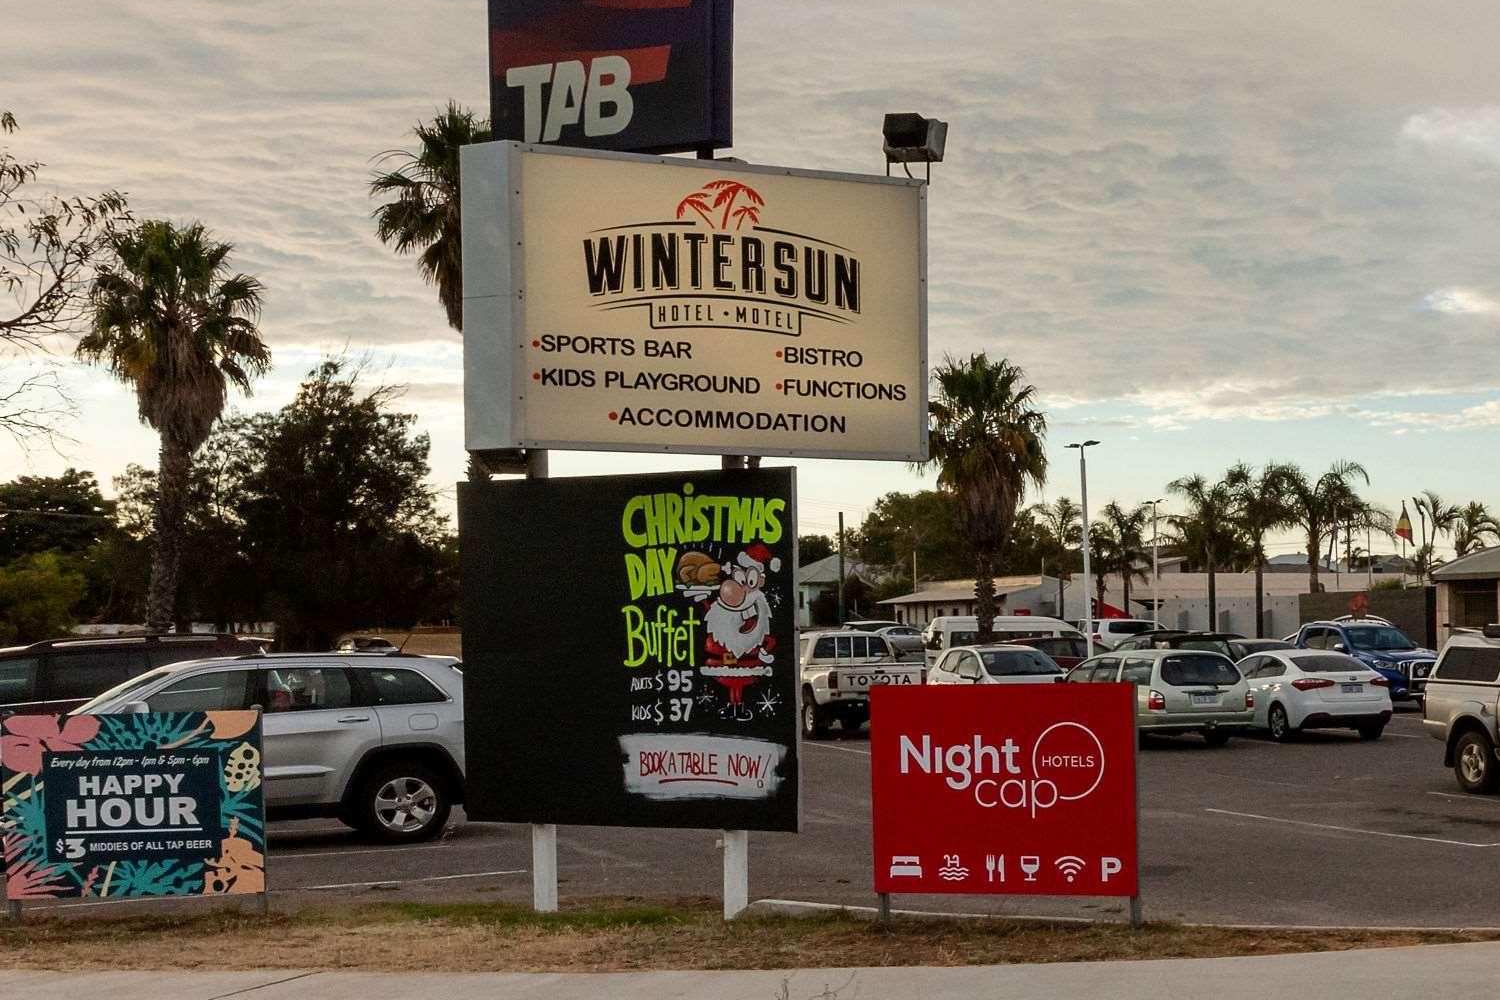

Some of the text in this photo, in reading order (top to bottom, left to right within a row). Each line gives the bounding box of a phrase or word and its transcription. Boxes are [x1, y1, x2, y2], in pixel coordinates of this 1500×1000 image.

[506, 55, 634, 143] TAB
[583, 231, 861, 315] WINTERSUN
[658, 305, 794, 330] HOTEL MOTEL
[541, 335, 692, 359] SPORTS BAR
[784, 347, 863, 368] BISTRO
[541, 368, 761, 395] KIDS PLAYGROUND
[784, 379, 907, 401] FUNCTIONS
[619, 408, 846, 434] ACCOMMODATION
[624, 549, 678, 600] DAY
[622, 605, 700, 667] Buffet
[847, 675, 912, 686] TOYOTA
[632, 704, 652, 721] KIDS
[51, 757, 75, 769] Every
[75, 757, 90, 769] day
[92, 756, 111, 767] from
[158, 756, 165, 765] &
[167, 755, 185, 766] 5pm
[640, 751, 772, 788] BOOK A TABLE NOW!
[900, 735, 1095, 790] Night HOTELS
[79, 774, 185, 796] HAPPY
[66, 796, 200, 828] HOUR
[975, 779, 1058, 819] cap
[90, 841, 128, 851] MIDDIES
[130, 841, 144, 850] OF
[145, 840, 164, 850] ALL
[166, 840, 184, 849] TAP
[186, 839, 212, 849] BEER
